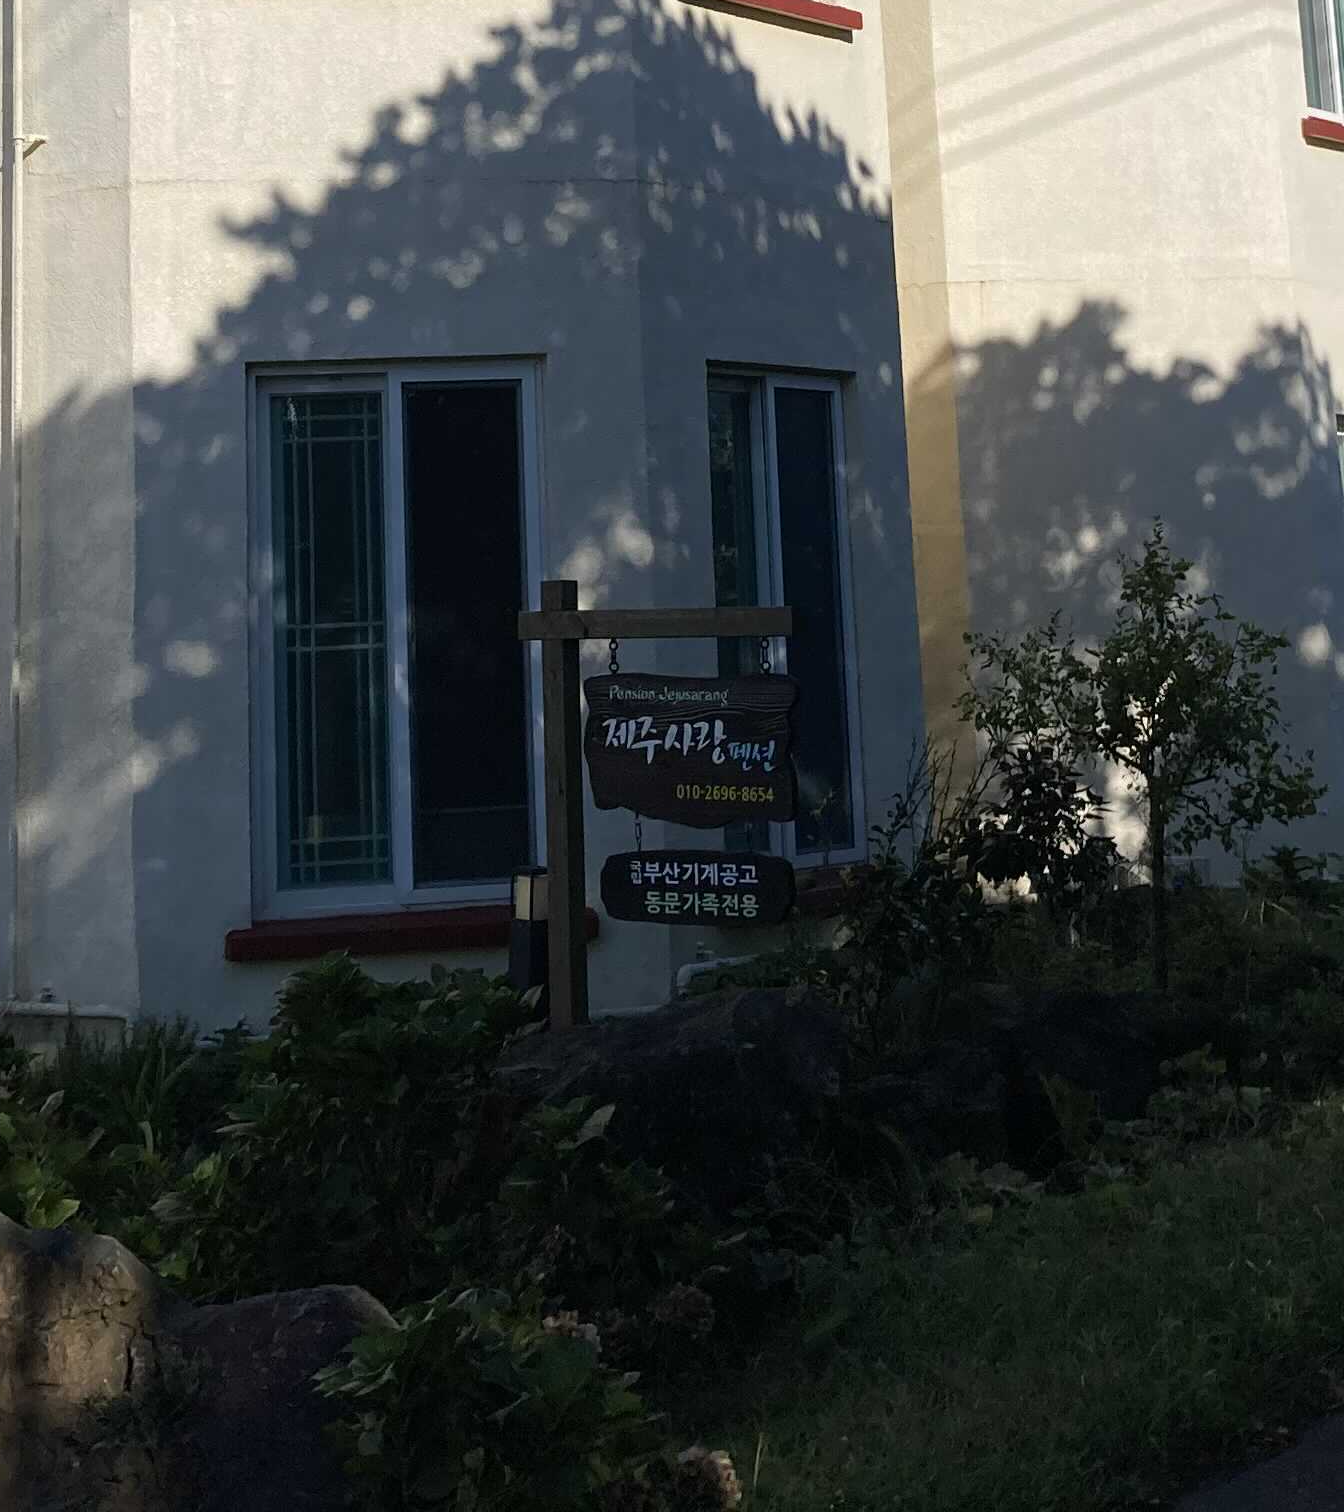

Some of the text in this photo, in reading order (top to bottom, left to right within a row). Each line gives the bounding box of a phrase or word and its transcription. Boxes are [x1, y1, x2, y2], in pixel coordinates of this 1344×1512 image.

[609, 684, 729, 706] Pension Jejusarang
[676, 783, 775, 802] 010-2696-8654
[643, 861, 759, 887] 부산기계공고
[644, 890, 760, 918] 동문가족전용
